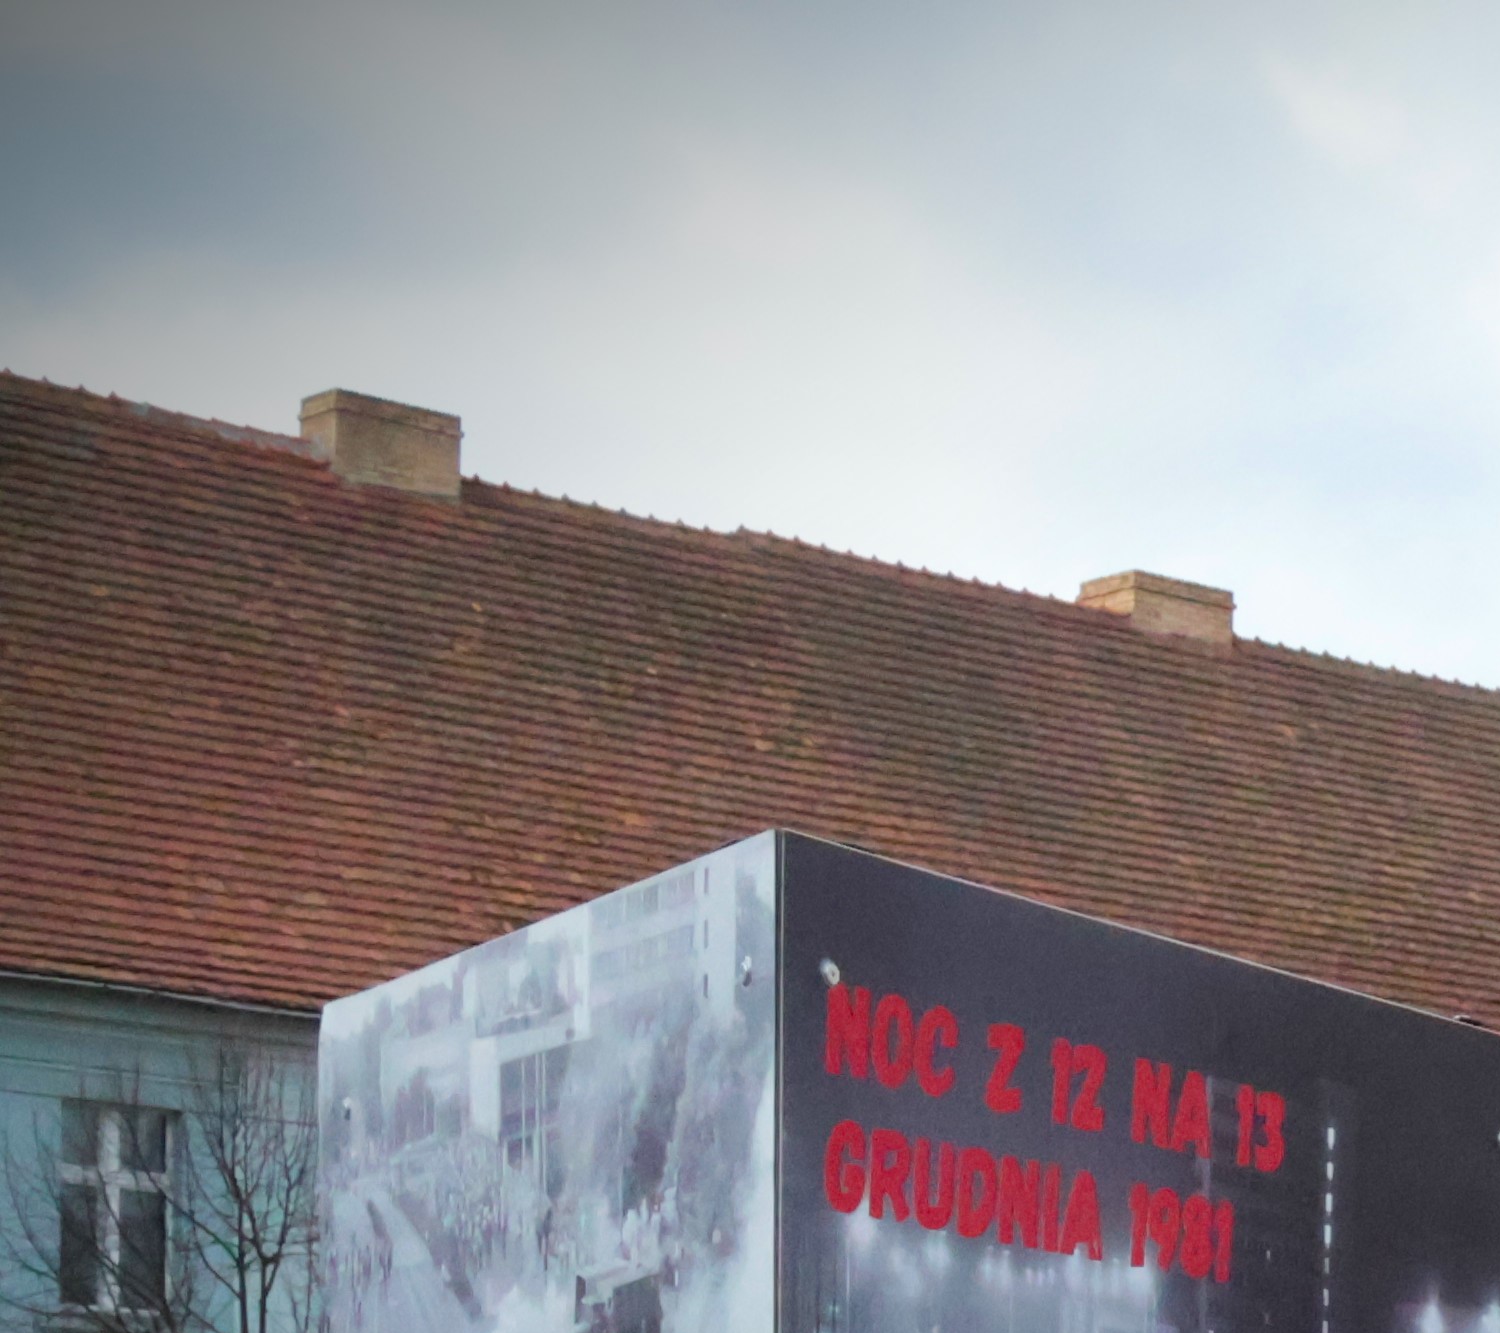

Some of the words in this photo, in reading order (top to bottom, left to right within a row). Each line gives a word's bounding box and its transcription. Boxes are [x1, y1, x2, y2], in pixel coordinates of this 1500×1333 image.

[825, 985, 958, 1097] NOC
[985, 1024, 1025, 1113] Z
[1052, 1039, 1107, 1131] 12
[1132, 1059, 1211, 1158] NA
[1236, 1085, 1285, 1172] 13
[825, 1120, 1102, 1259] GRUDNIA
[1130, 1184, 1234, 1281] 1981
